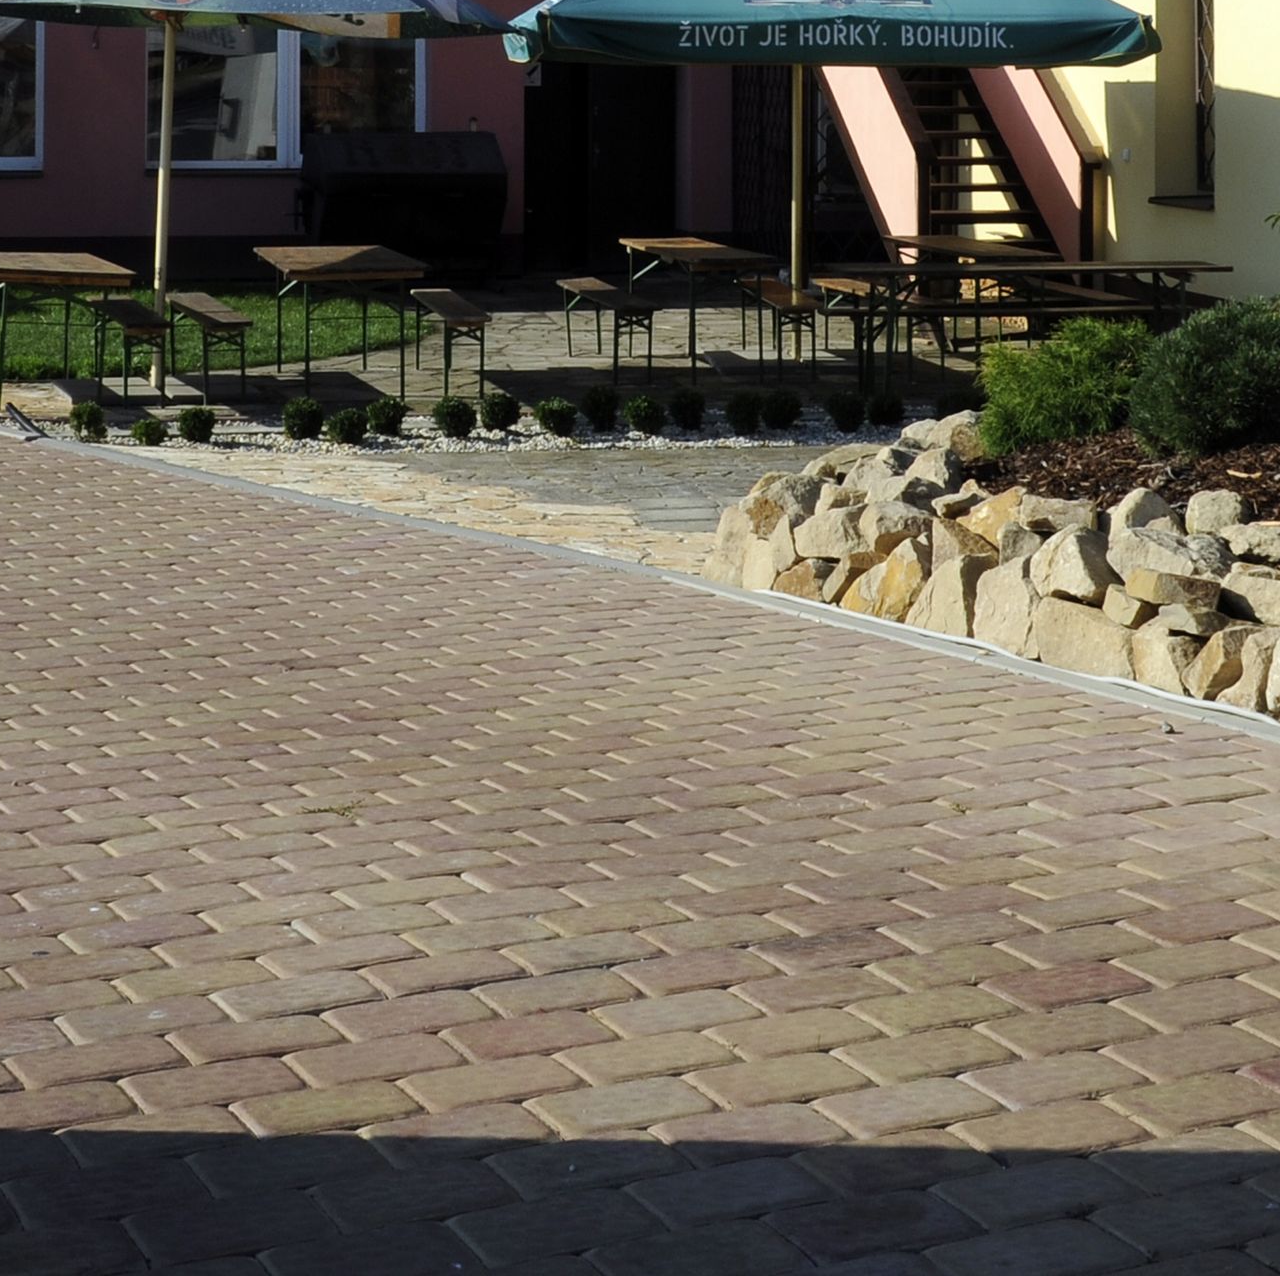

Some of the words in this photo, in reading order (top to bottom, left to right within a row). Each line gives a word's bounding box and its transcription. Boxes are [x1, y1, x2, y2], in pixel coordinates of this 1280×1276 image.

[678, 21, 749, 47] ŽIVOT
[759, 24, 787, 46] JE
[798, 18, 888, 47] HOŘKÝ.
[901, 22, 1015, 49] BOHUDÍK.
